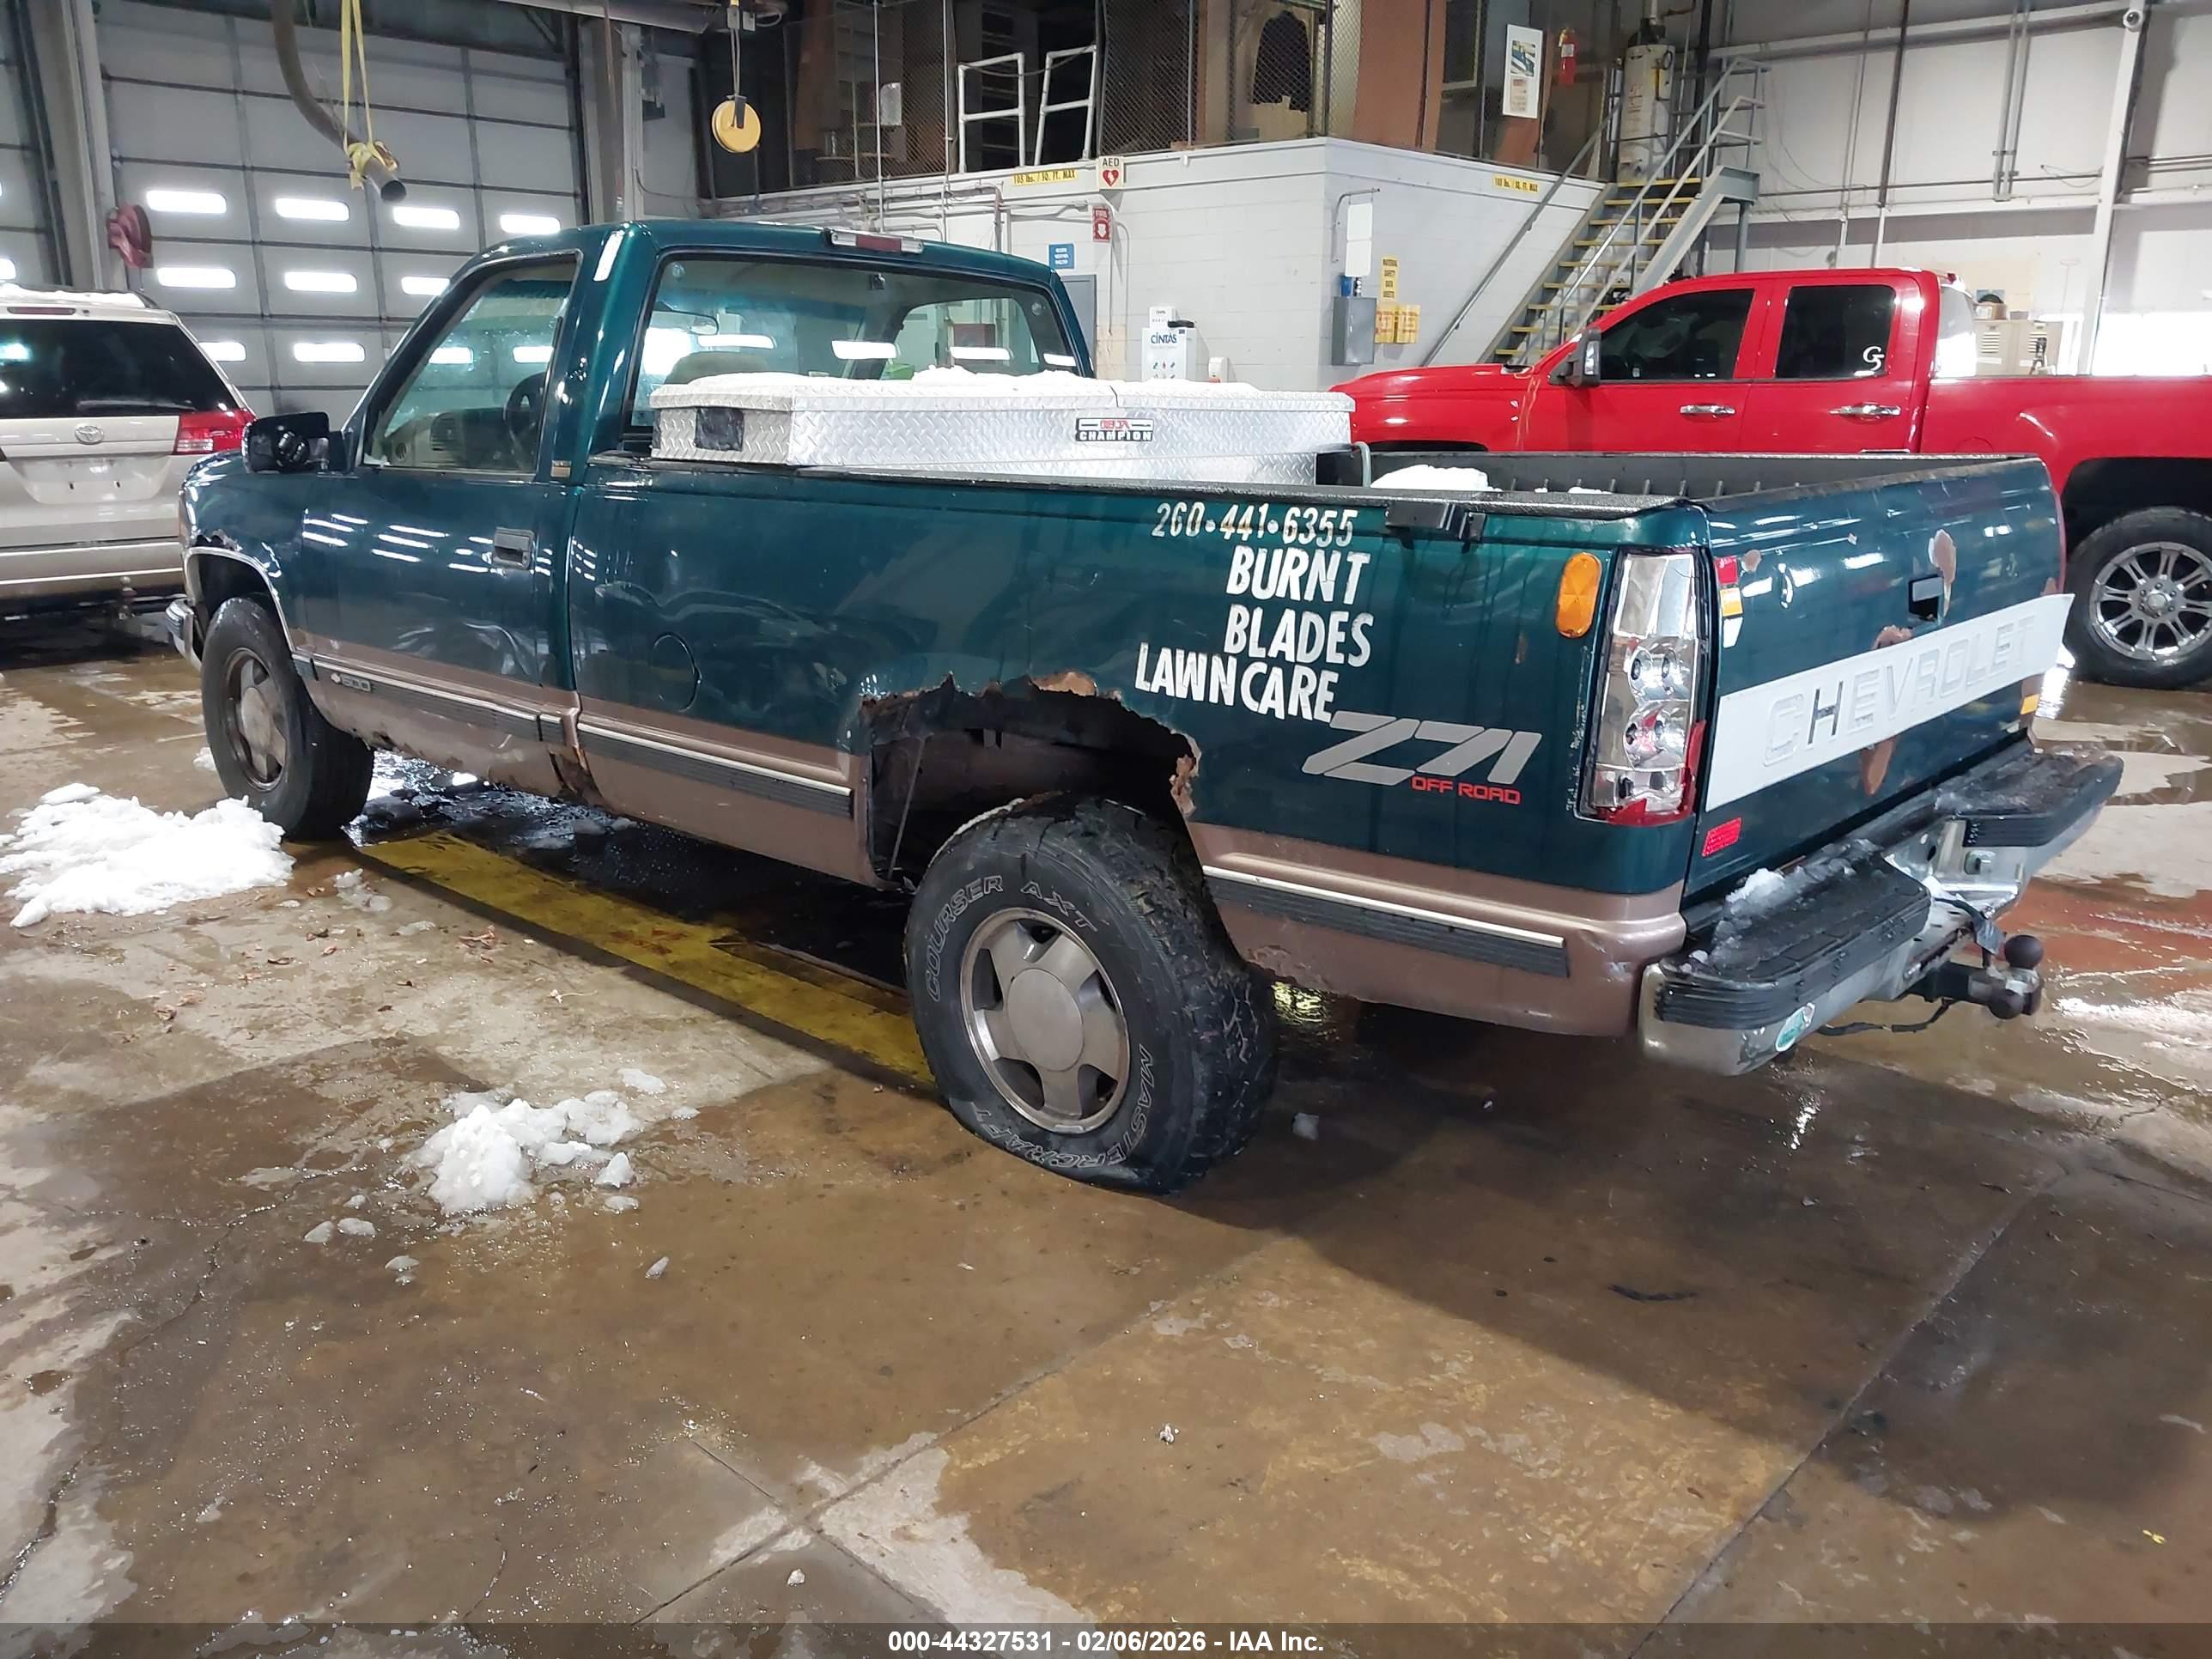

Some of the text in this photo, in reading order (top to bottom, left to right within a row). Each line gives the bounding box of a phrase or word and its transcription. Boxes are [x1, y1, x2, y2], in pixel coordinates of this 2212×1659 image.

[1063, 169, 1076, 179] MAX
[1102, 158, 1120, 167] AED
[1079, 431, 1152, 441] CHAMPION
[1226, 545, 1371, 605] BURNT
[1224, 604, 1374, 667] BLADES
[1763, 616, 2035, 766] CHEVROLET
[1302, 710, 1542, 786] Z71
[1411, 775, 1521, 805] OFF ROAD
[926, 875, 1098, 1003] COURSER AXT
